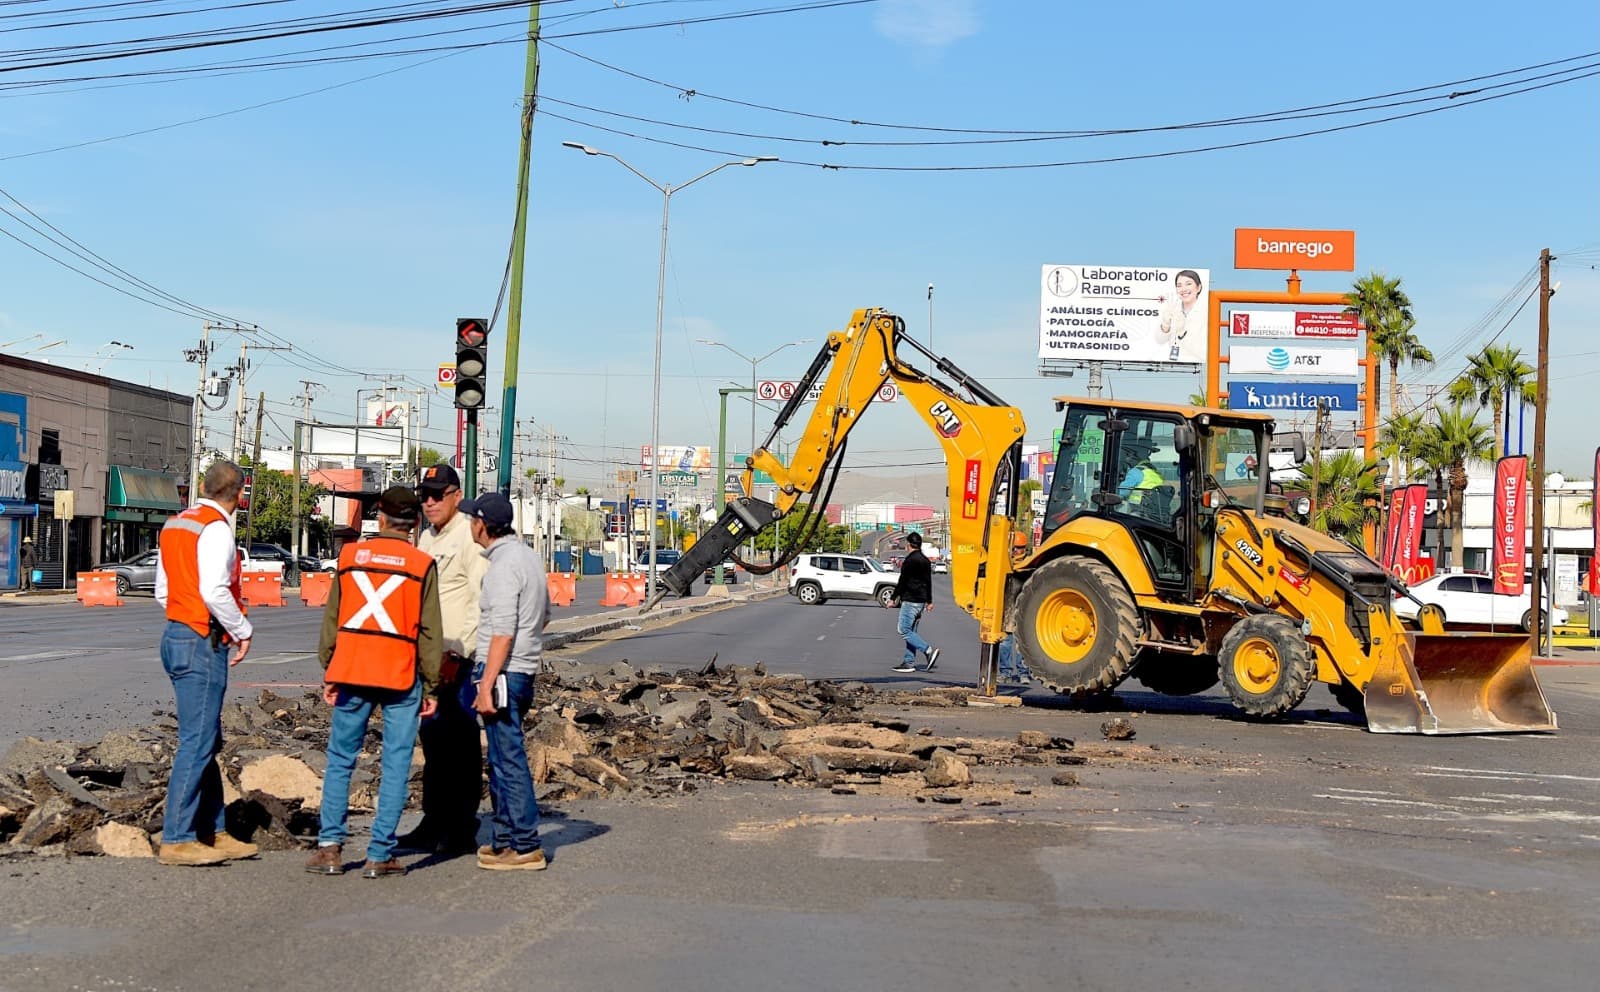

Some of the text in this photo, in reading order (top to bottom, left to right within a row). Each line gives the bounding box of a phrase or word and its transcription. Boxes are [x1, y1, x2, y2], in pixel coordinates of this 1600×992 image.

[1258, 237, 1333, 258] banregio
[1081, 267, 1168, 282] Laboratorio
[1081, 282, 1131, 295] Ramos
[1050, 306, 1159, 317] ANÁLISIS CLÍNICOS
[1050, 318, 1115, 327] PATOLOGÍA
[1049, 330, 1128, 339] MAMOGRAFÍA
[1049, 341, 1130, 351] ULTRASONIDO
[1294, 355, 1322, 366] AT&T
[882, 388, 892, 396] 60
[1260, 391, 1342, 408] unitam
[930, 401, 959, 432] CAT
[1504, 476, 1517, 558] me encanta
[1236, 540, 1262, 566] 426F2
